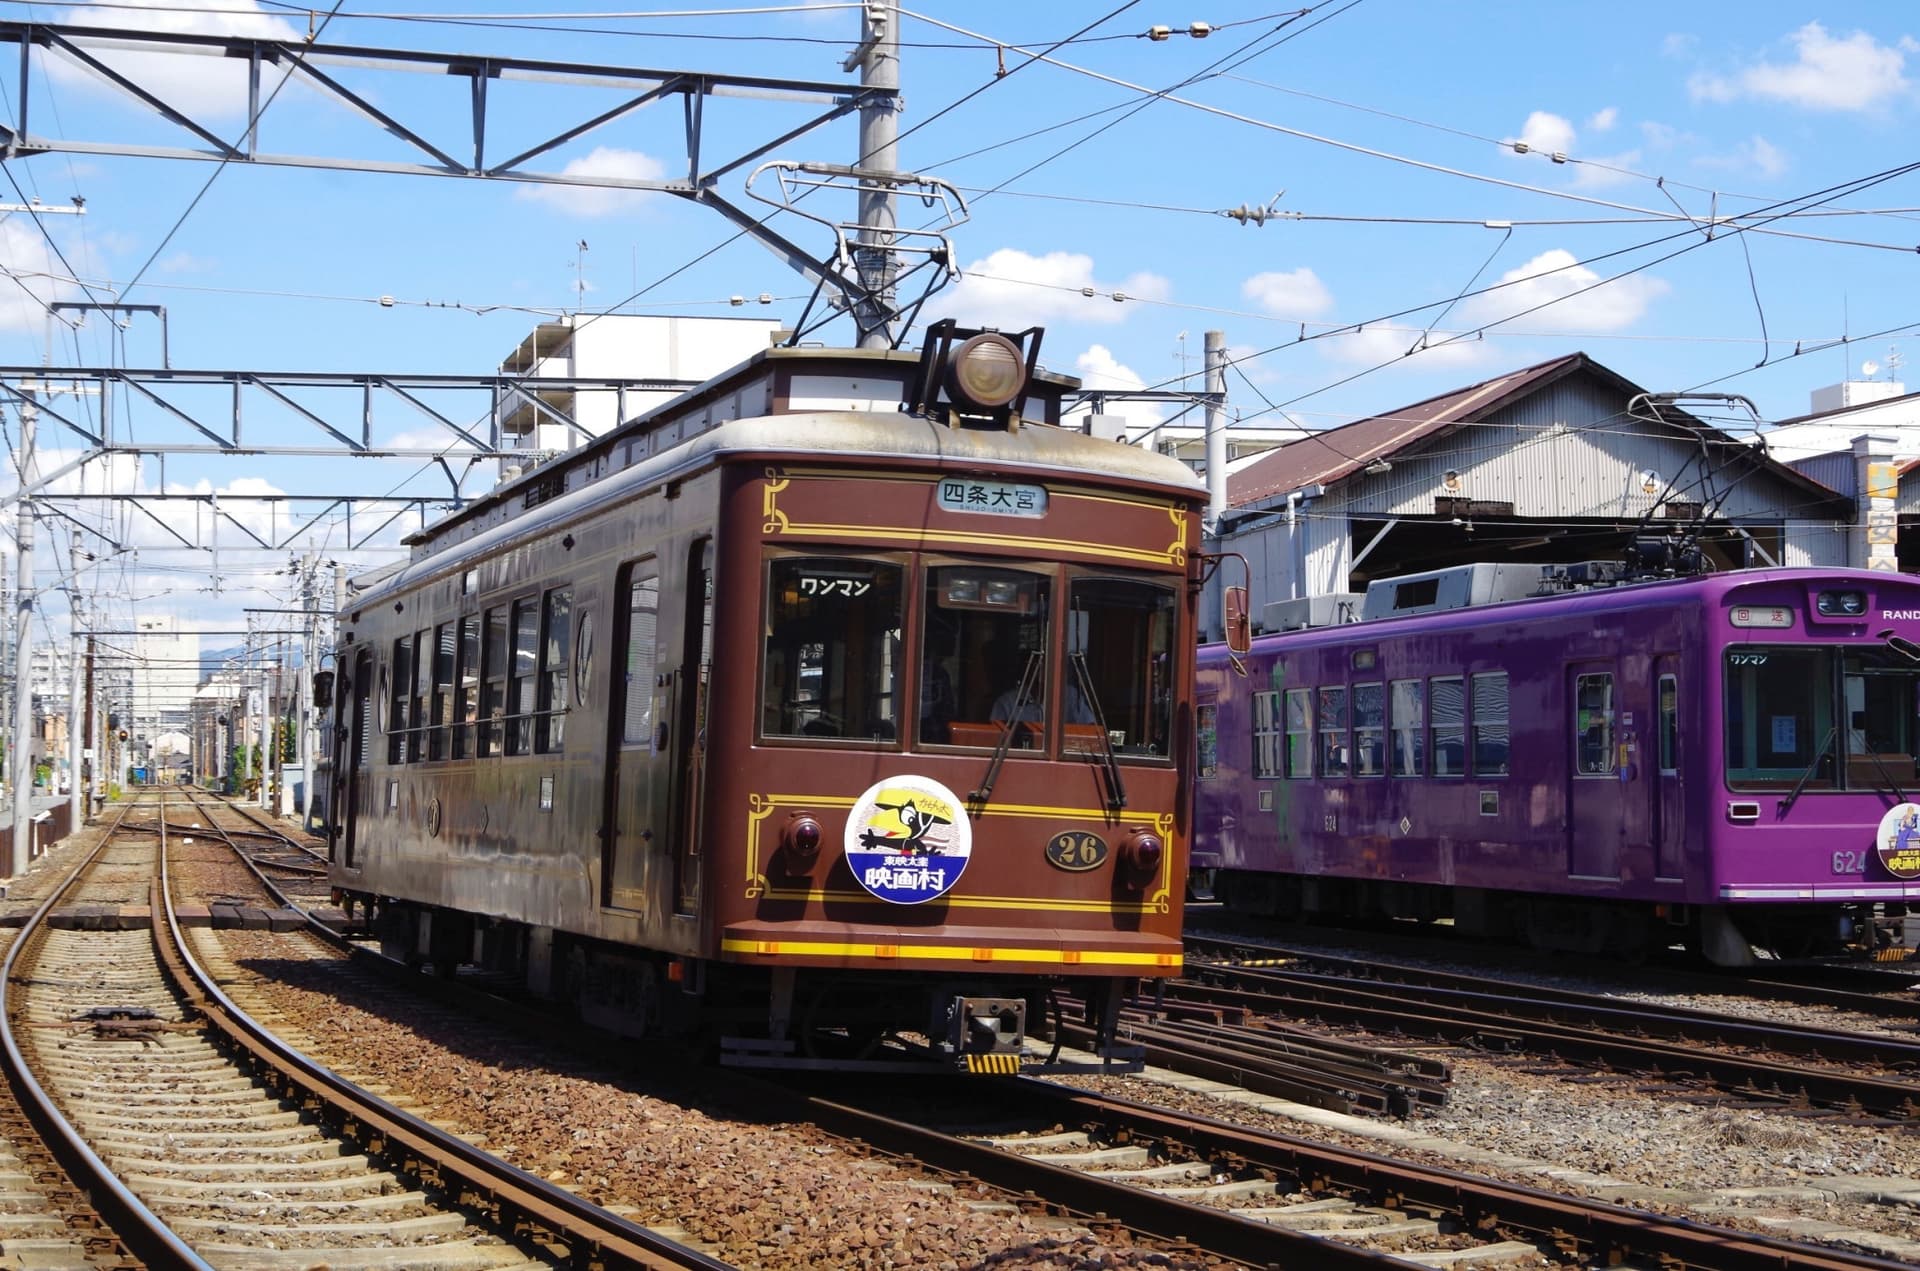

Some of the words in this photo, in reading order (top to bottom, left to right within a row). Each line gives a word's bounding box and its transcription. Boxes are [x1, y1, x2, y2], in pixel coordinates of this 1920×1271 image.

[1644, 472, 1656, 488] 4
[944, 483, 1035, 510] 四条大宮
[801, 578, 870, 596] ワンマン
[1883, 610, 1920, 620] RAND
[1730, 655, 1767, 665] ワンマン
[1059, 835, 1097, 863] 26
[1833, 851, 1866, 873] 624
[865, 867, 946, 891] 映画村
